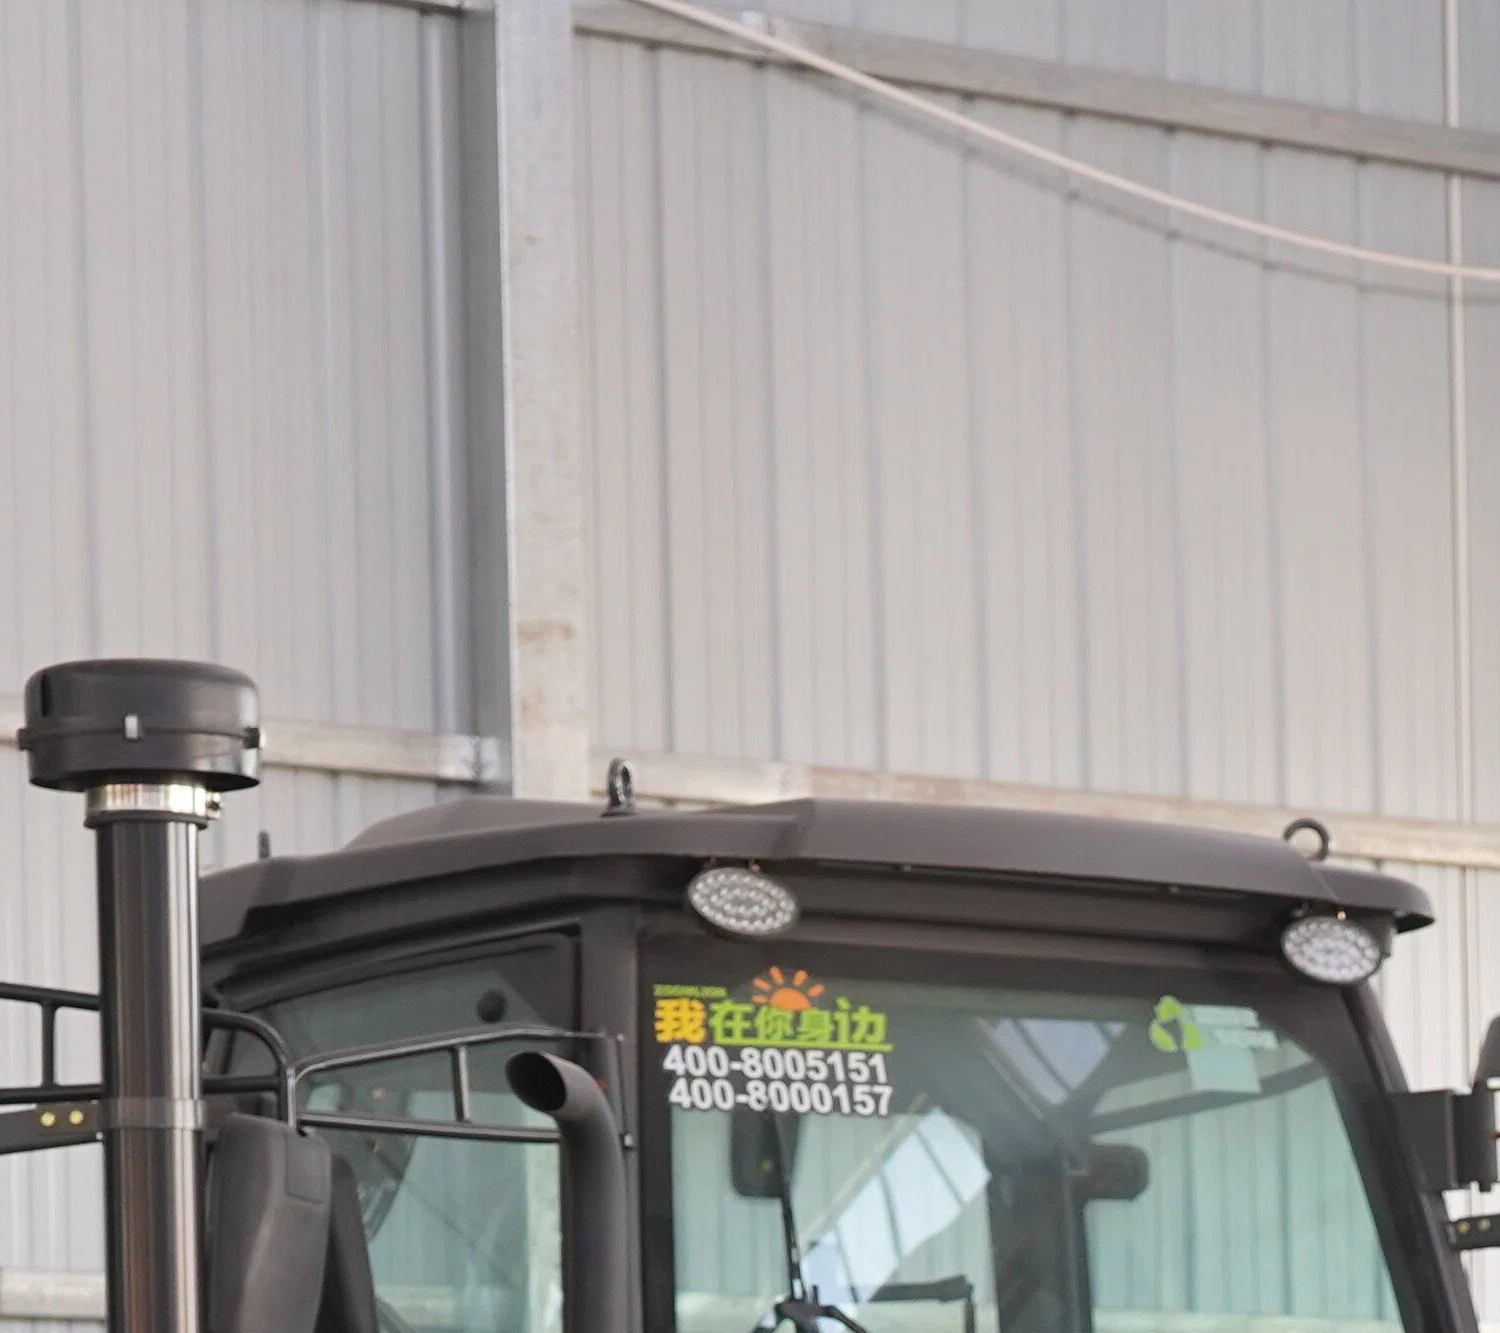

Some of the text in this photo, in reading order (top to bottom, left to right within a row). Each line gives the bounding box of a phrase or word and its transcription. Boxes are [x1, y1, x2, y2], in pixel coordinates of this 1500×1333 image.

[654, 996, 888, 1044] 我在你身边
[662, 1043, 888, 1084] 400-8005151
[668, 1077, 893, 1116] 400-8000157
